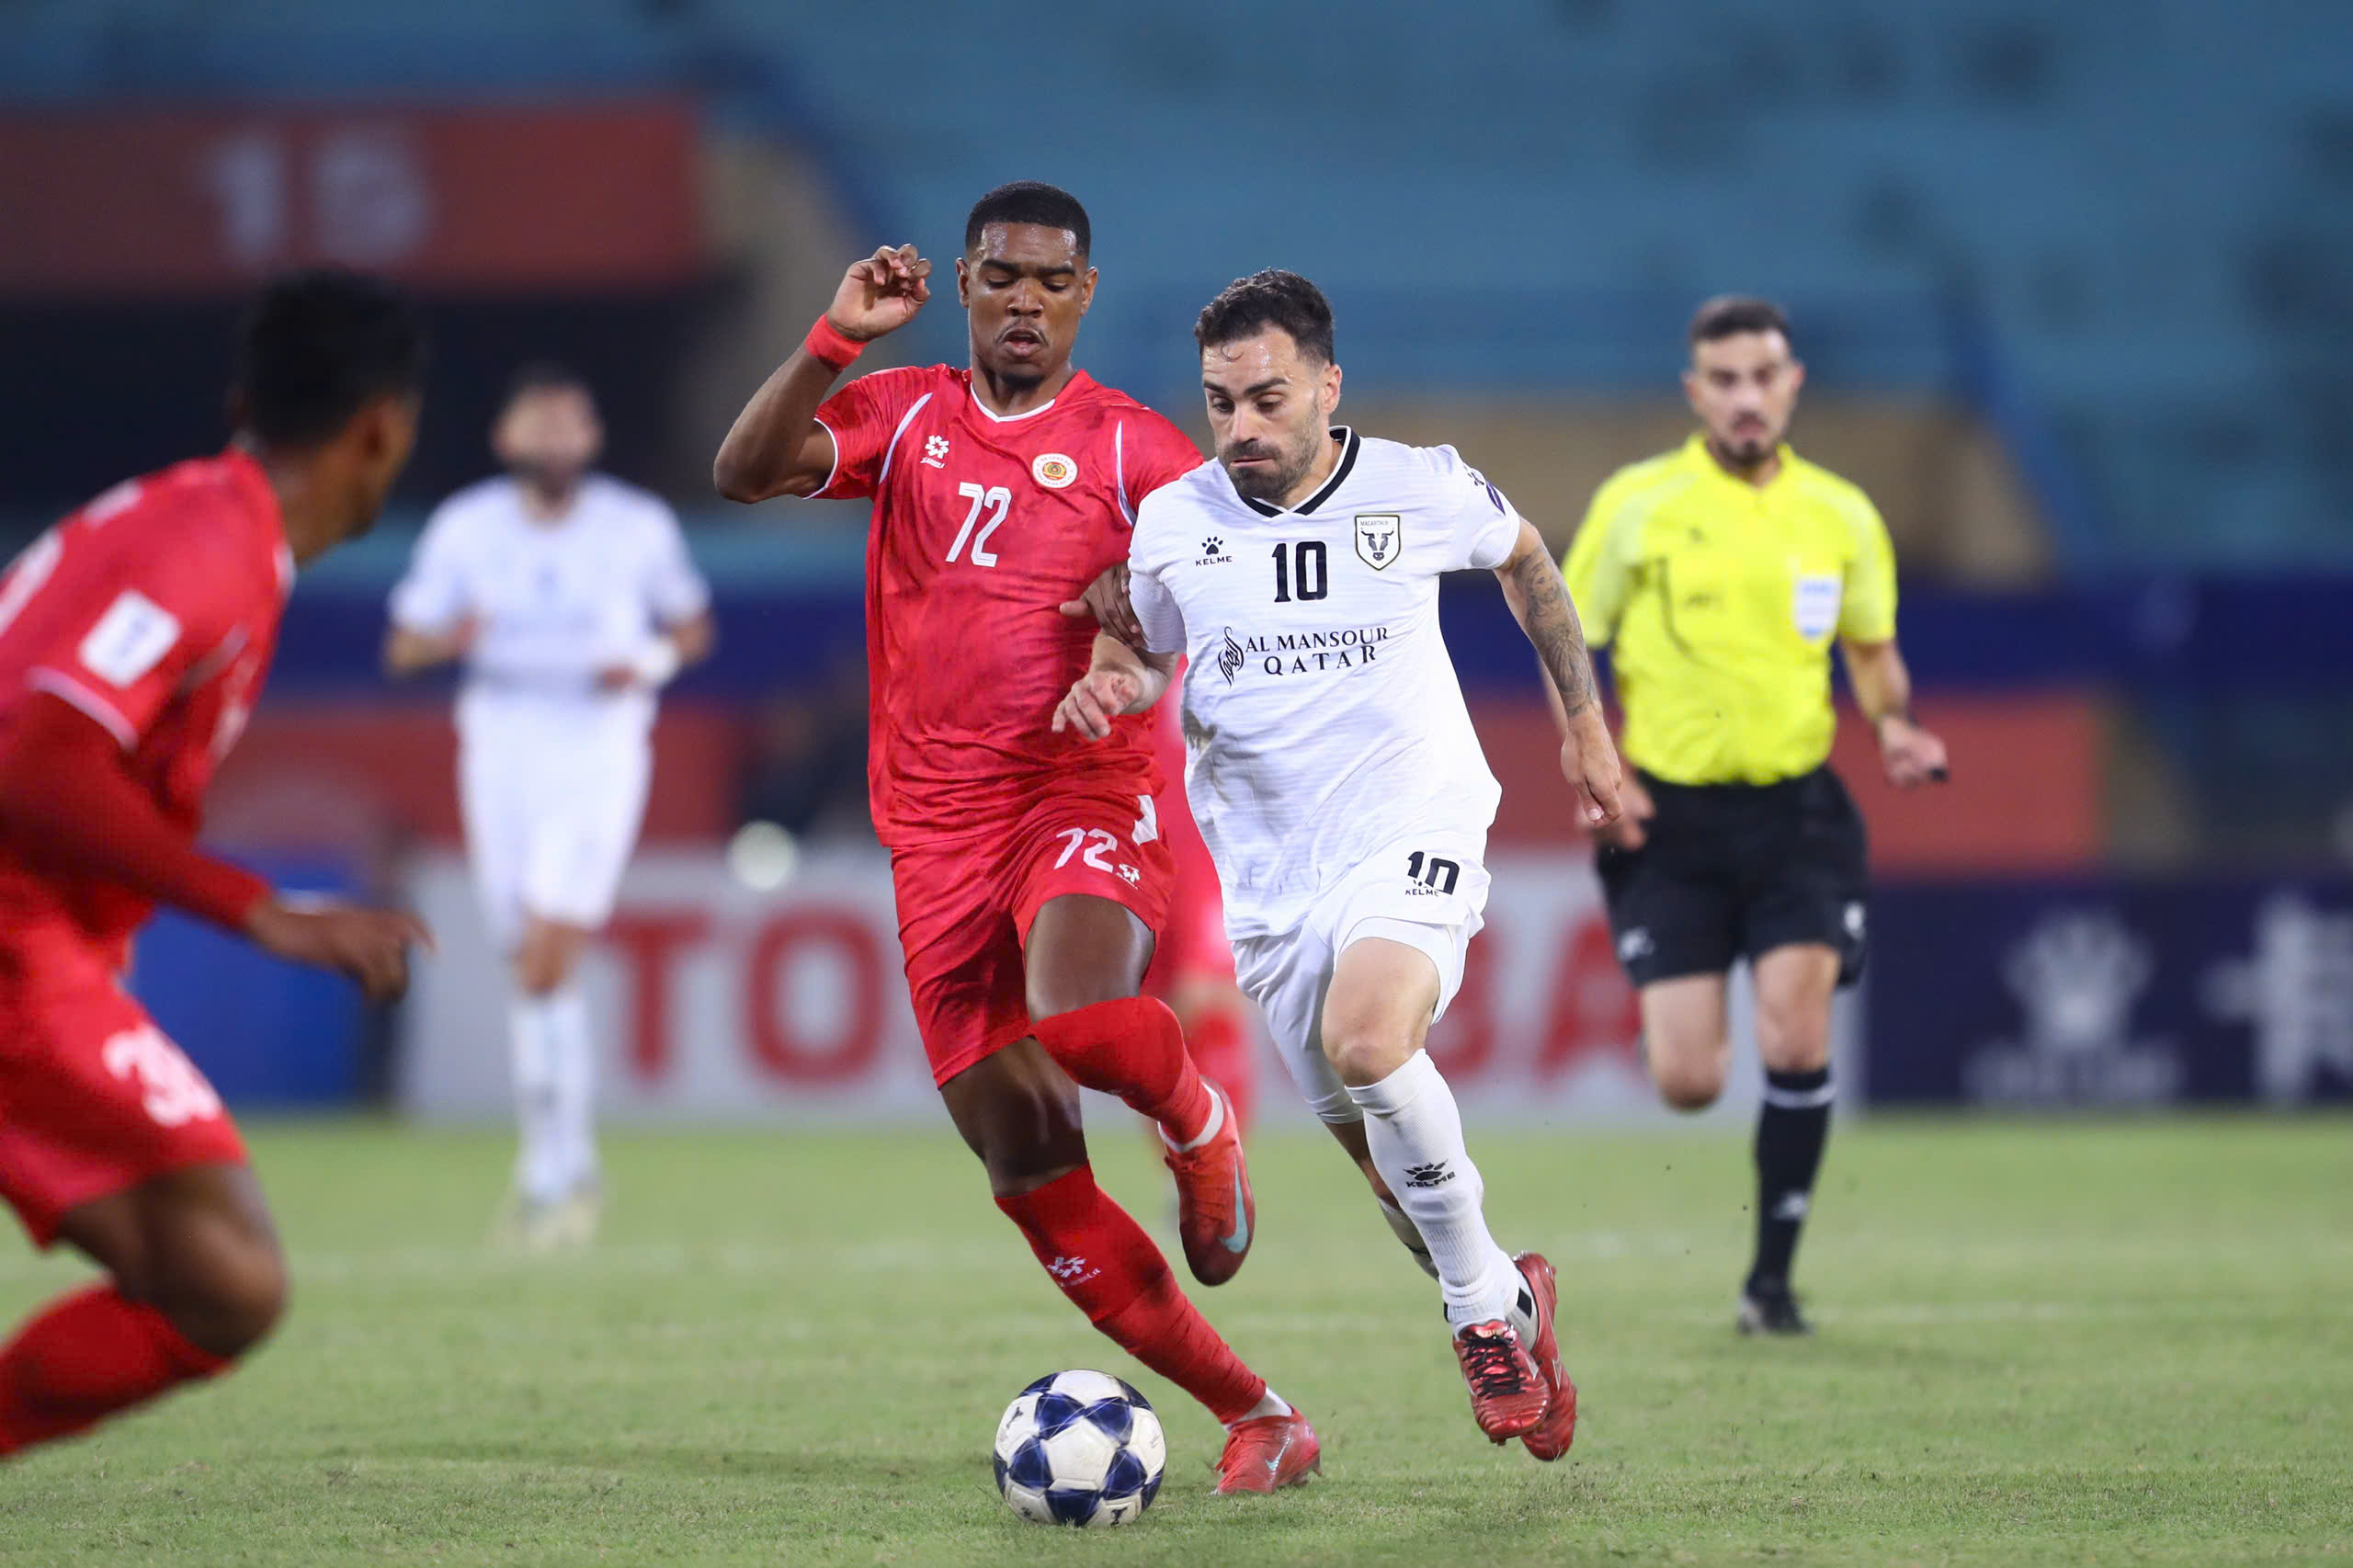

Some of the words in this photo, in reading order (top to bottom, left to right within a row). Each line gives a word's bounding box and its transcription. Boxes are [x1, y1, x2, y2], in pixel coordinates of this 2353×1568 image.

[945, 482, 1012, 567] 72
[1195, 555, 1233, 566] KELME
[1271, 540, 1327, 603] 10
[1245, 636, 1269, 653] AL
[1277, 627, 1388, 651] MANSOUR
[1264, 644, 1376, 676] QATAR
[1053, 827, 1118, 873] 72
[1405, 1171, 1456, 1187] KELME
